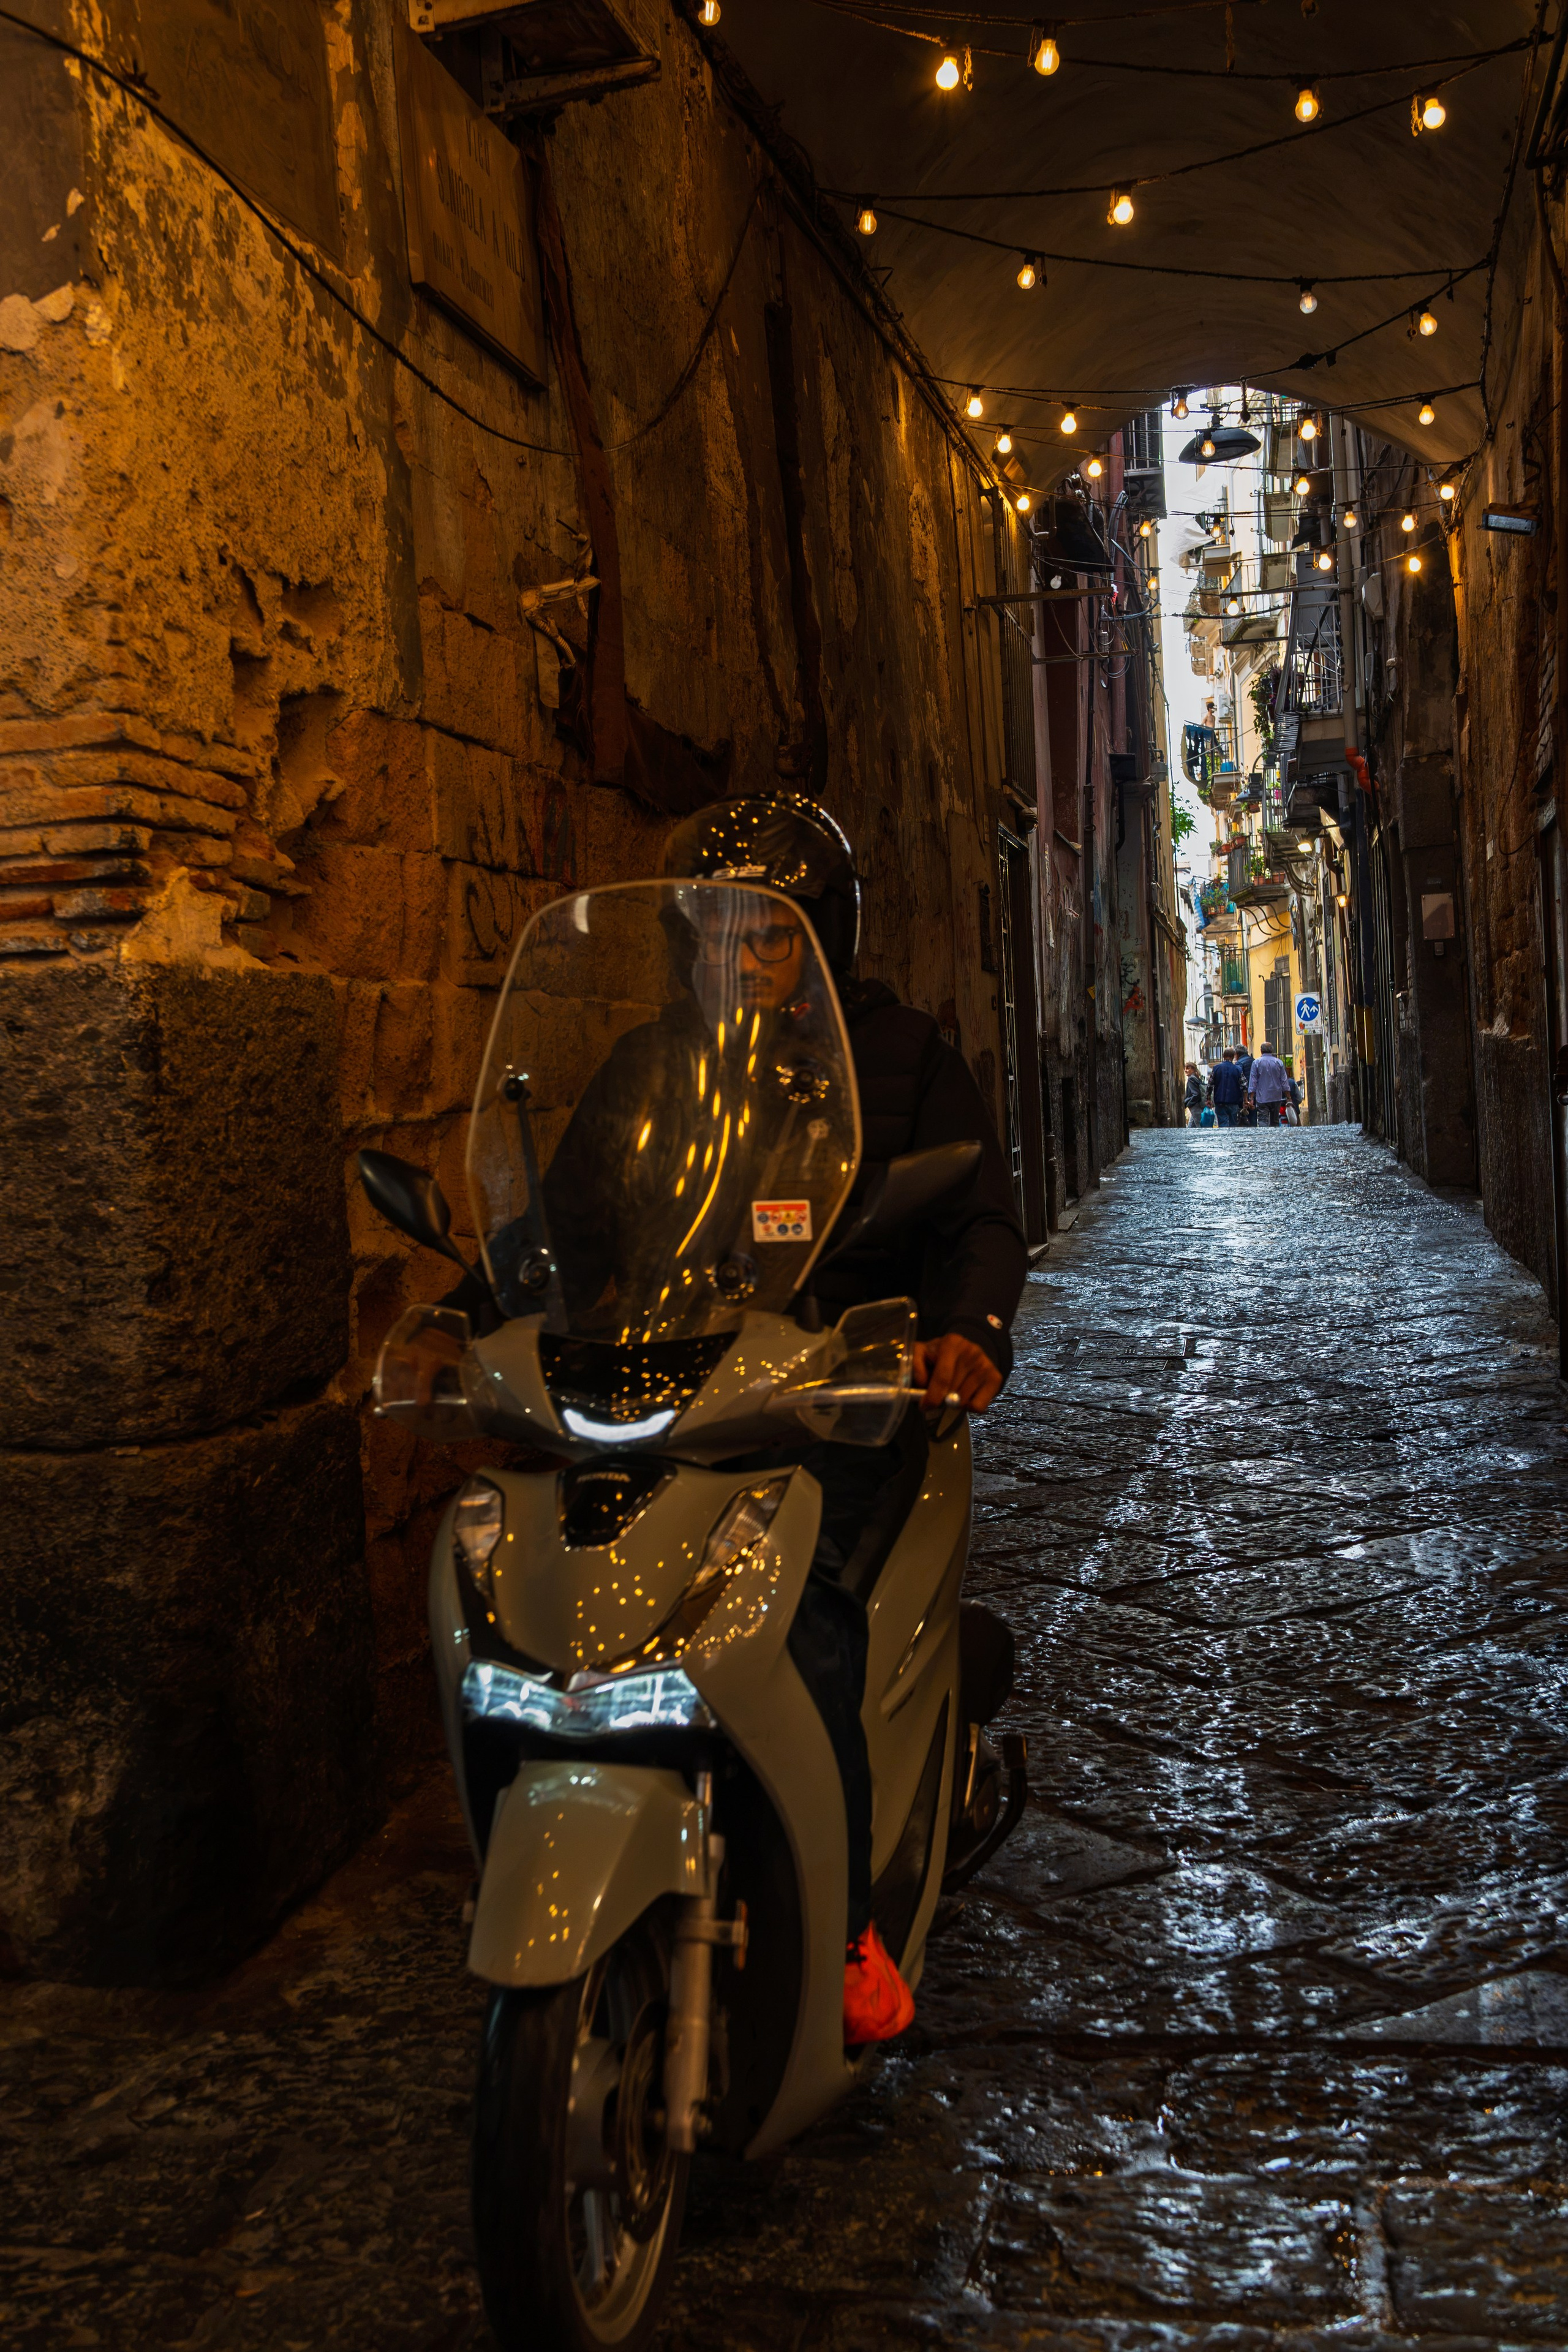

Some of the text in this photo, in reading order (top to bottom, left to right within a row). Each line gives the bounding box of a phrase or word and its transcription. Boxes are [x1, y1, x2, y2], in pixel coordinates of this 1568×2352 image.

[465, 117, 490, 176] VICO
[437, 154, 526, 282] S.NICOLA A NILO
